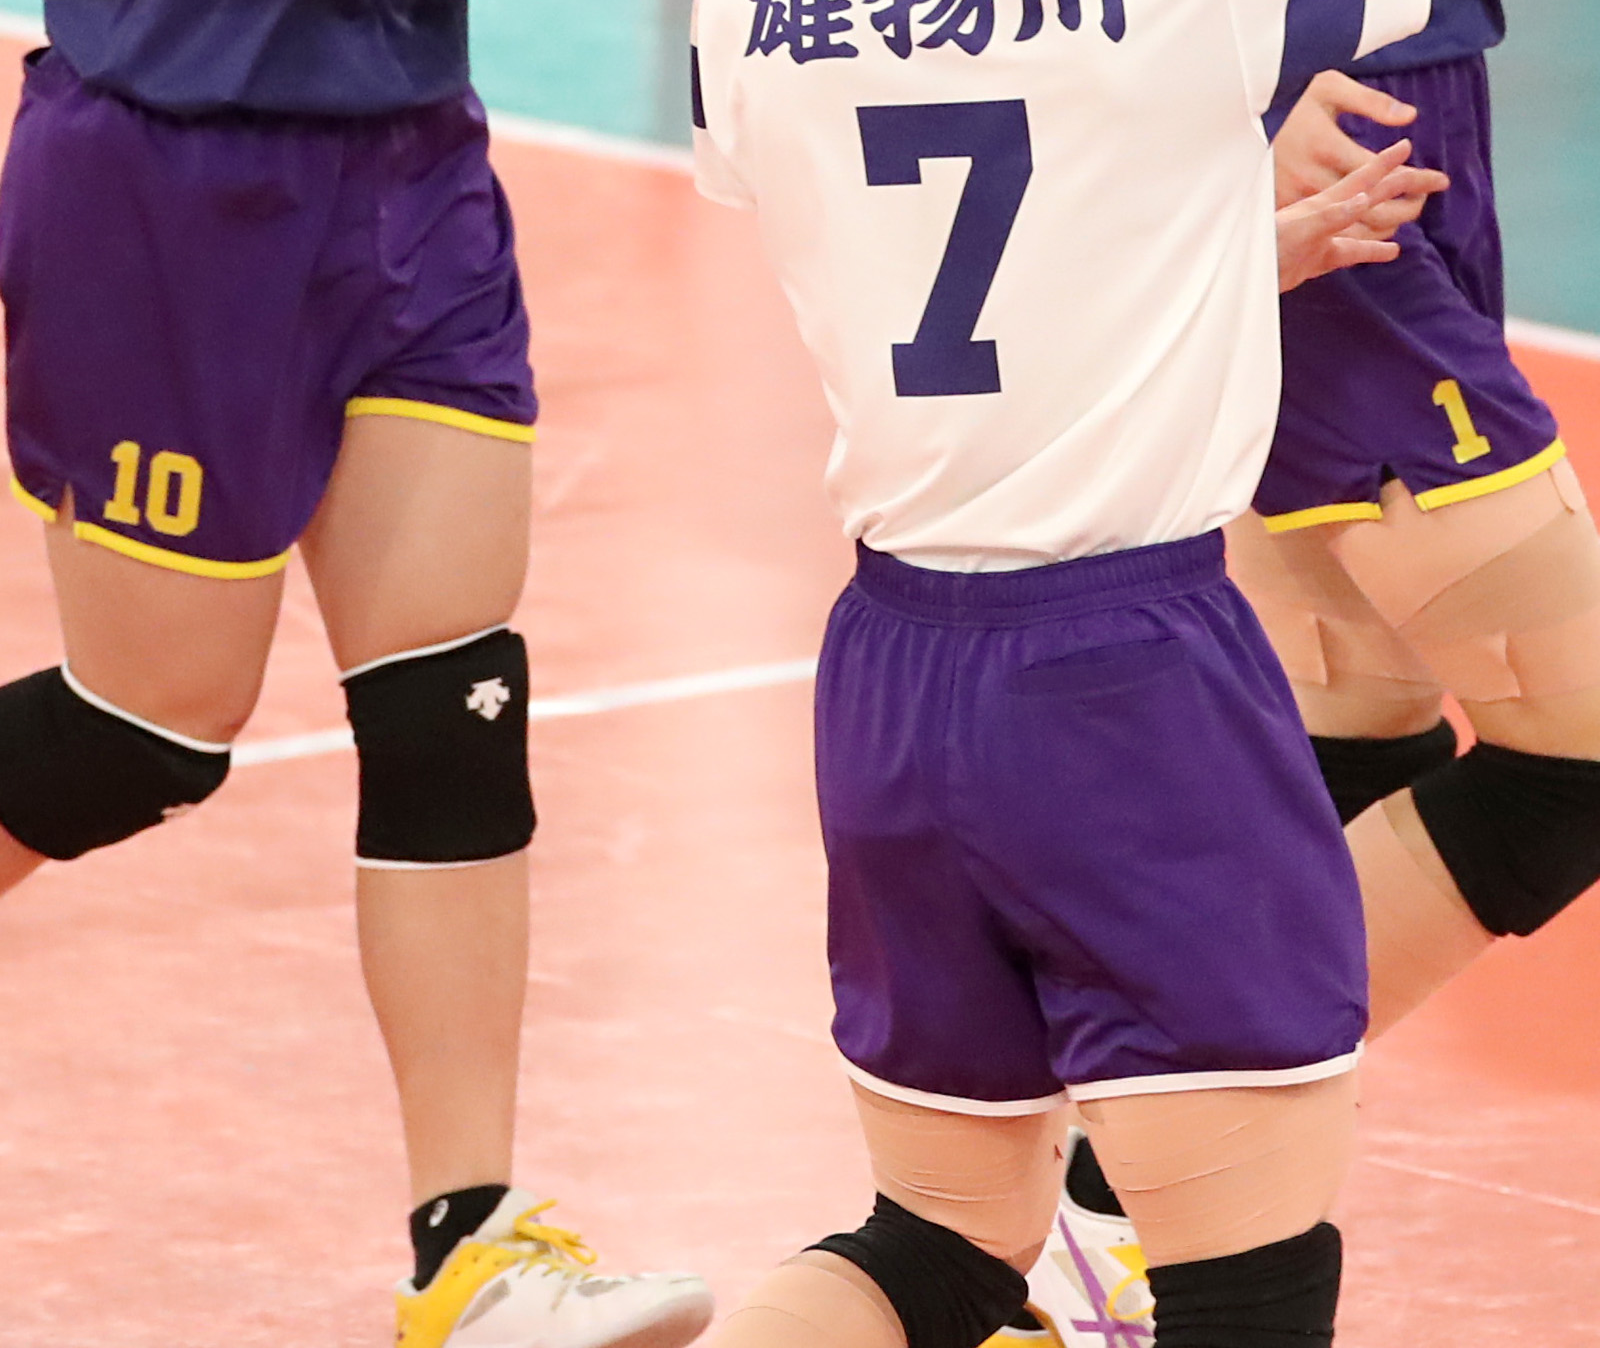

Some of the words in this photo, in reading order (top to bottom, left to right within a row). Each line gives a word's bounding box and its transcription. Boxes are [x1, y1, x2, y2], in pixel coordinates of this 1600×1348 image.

[855, 98, 1034, 397] 7
[1431, 378, 1492, 465] 1
[102, 439, 204, 538] 10
